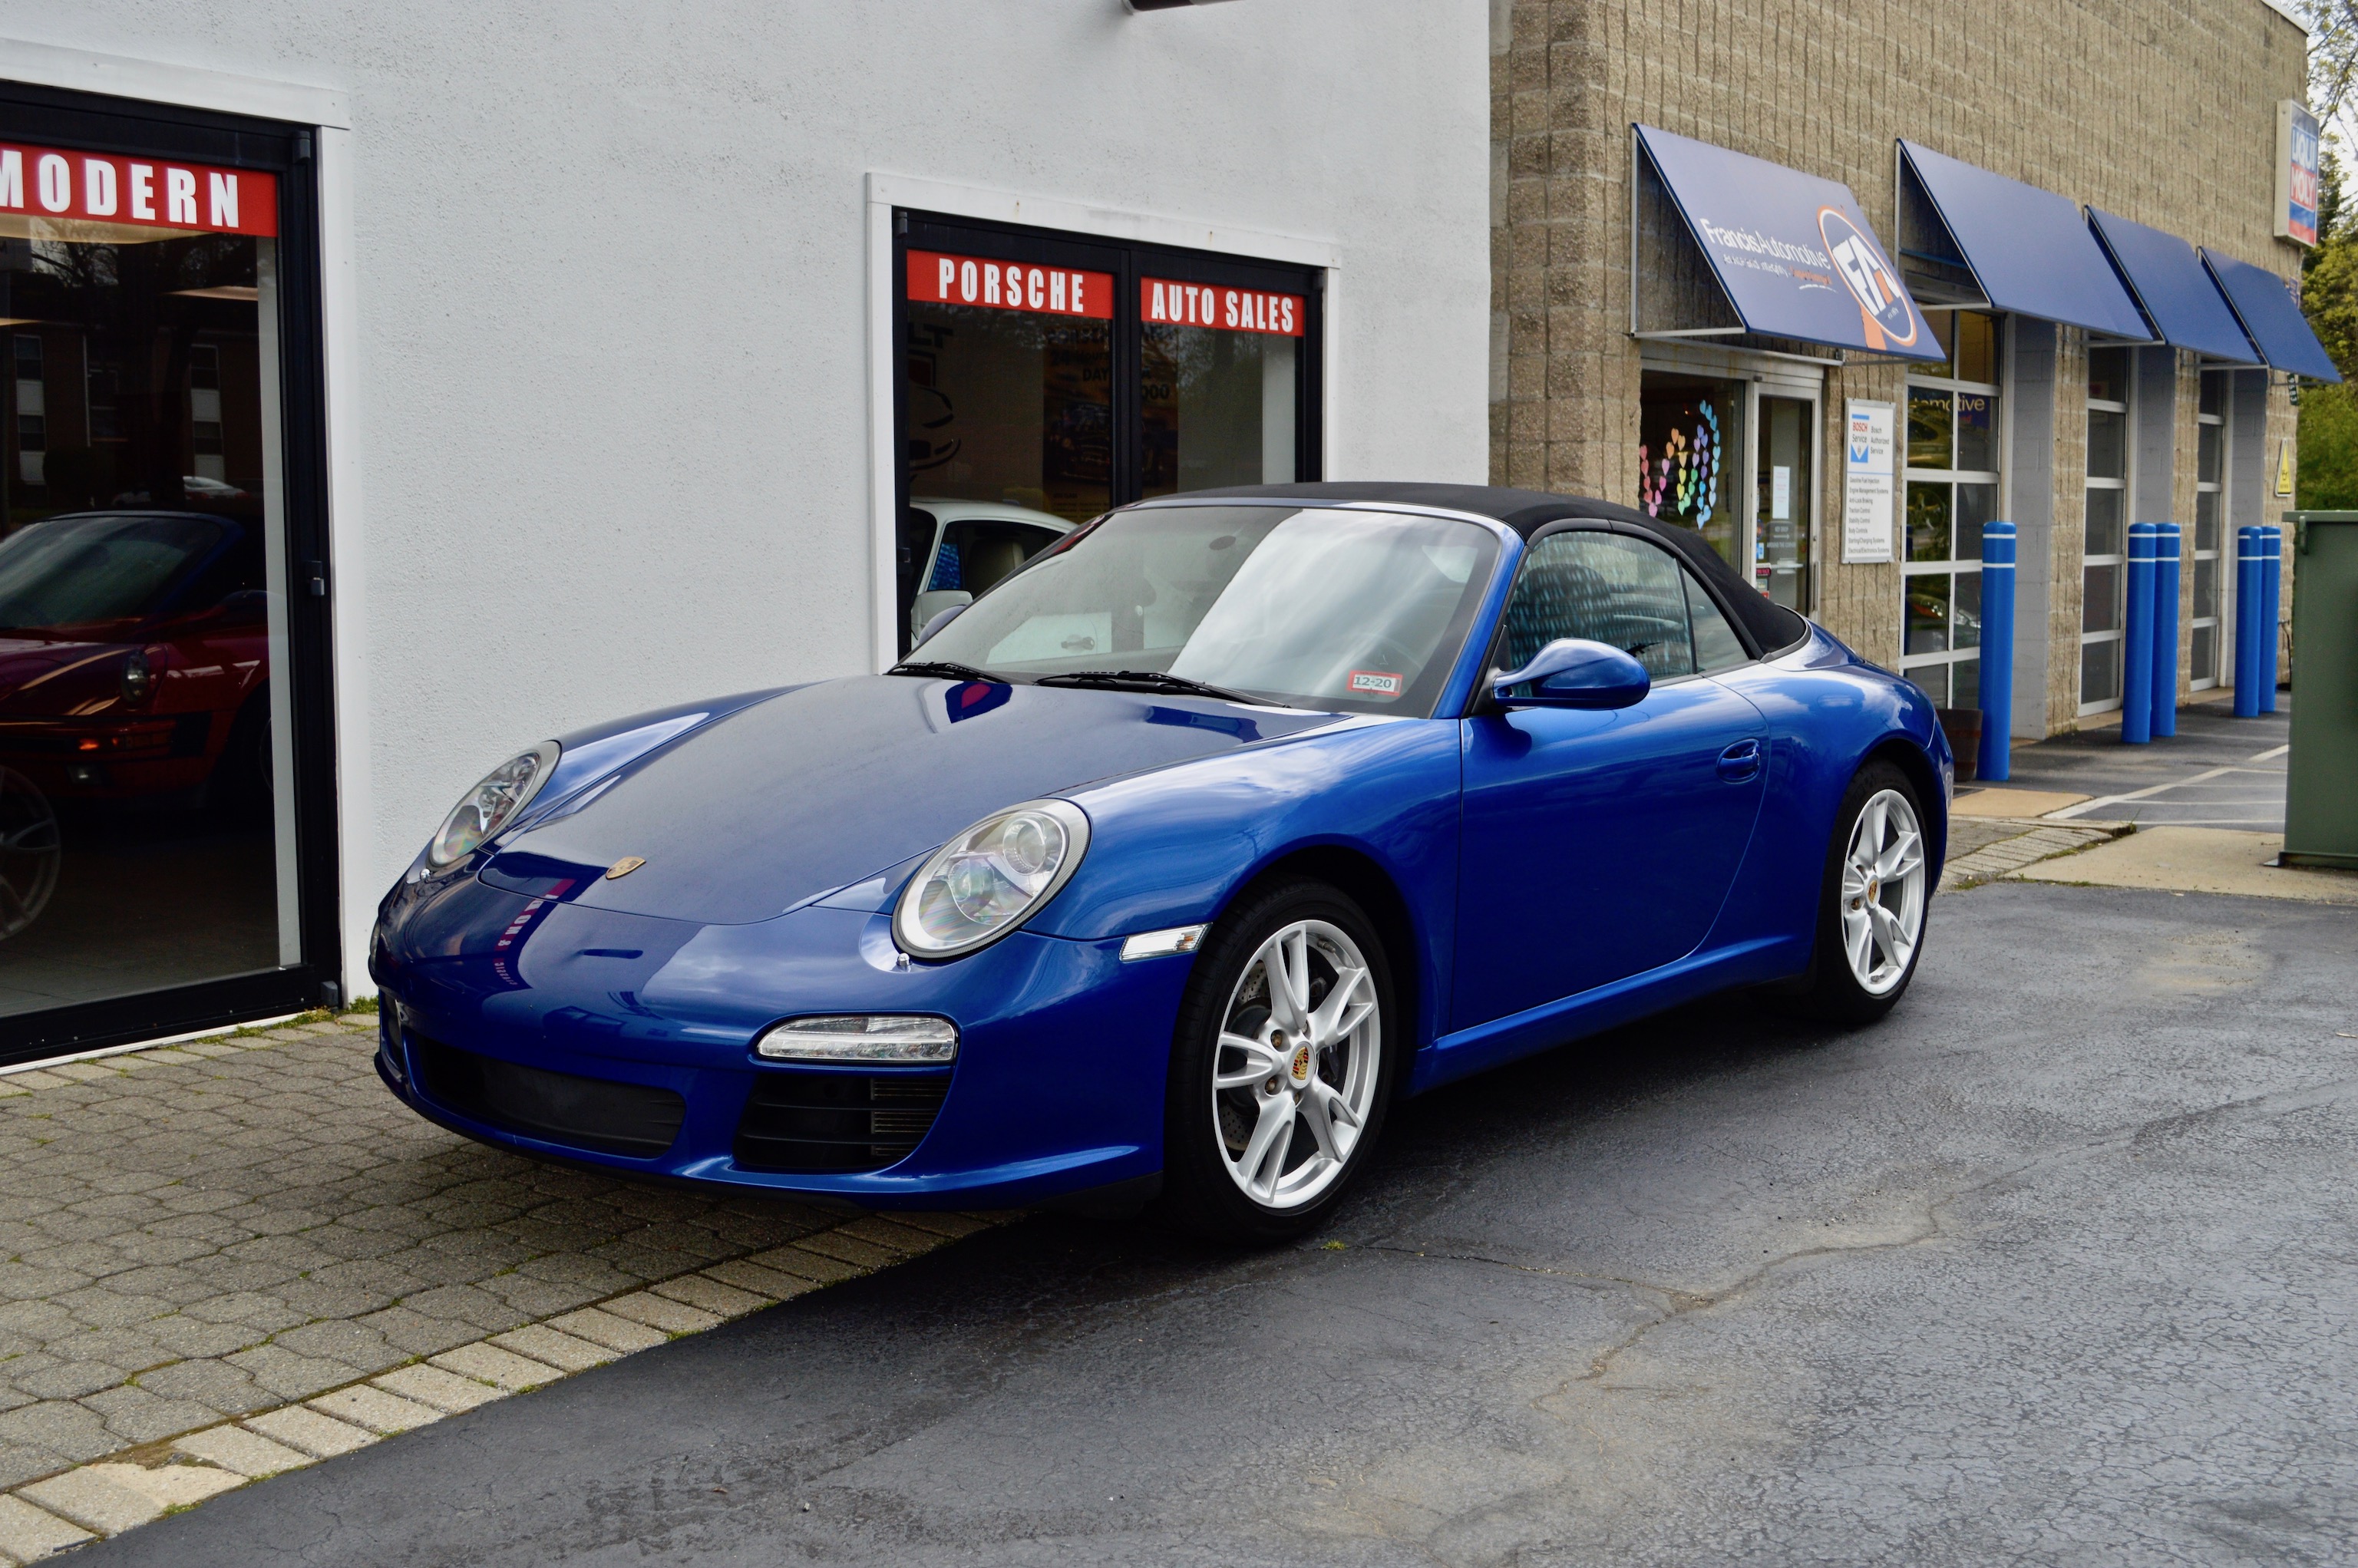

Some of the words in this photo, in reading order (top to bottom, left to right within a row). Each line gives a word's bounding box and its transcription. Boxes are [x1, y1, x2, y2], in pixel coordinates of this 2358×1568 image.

[2292, 129, 2317, 170] LIQUI
[0, 150, 239, 228] MODERN
[2290, 166, 2316, 206] MOLY
[939, 258, 1085, 313] PORSCHE
[1151, 282, 1215, 325] AUTO
[1226, 291, 1294, 333] SALES
[1851, 434, 1868, 444] Service
[1852, 421, 1868, 433] BOSCH
[1870, 447, 1884, 455] Service
[1353, 676, 1392, 688] 12-20
